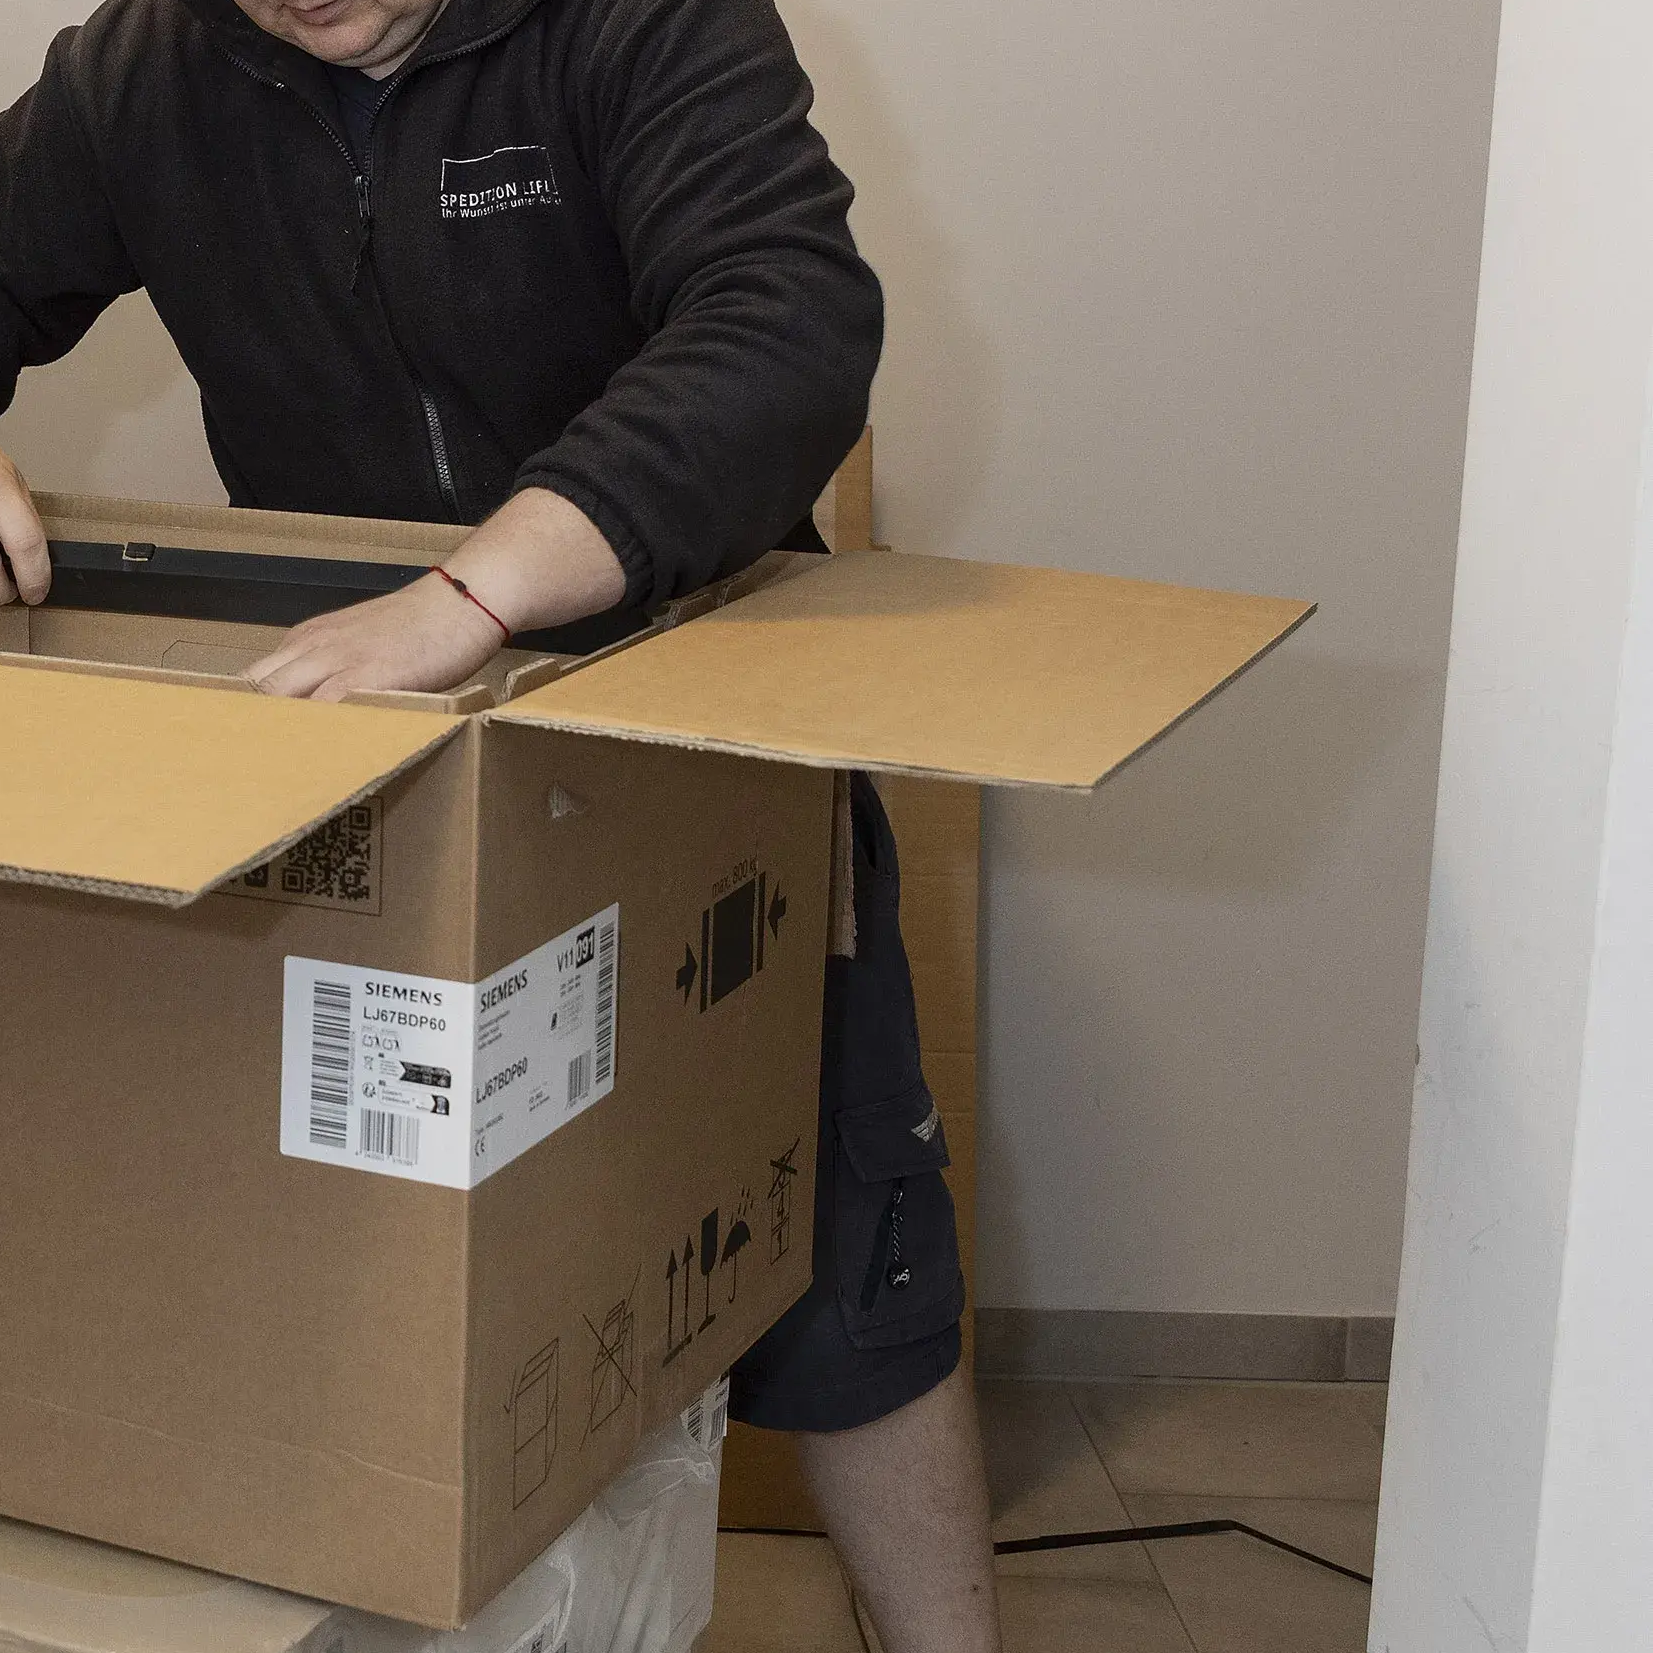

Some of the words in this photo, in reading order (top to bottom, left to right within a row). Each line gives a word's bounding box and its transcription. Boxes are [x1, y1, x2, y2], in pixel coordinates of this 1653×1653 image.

[440, 182, 517, 207] SPEDITION
[557, 947, 574, 973] V11
[576, 931, 595, 963] 091
[365, 981, 444, 1006] SIEMENS
[480, 968, 528, 1013] SIEMENS
[363, 1006, 447, 1031] LJ67BDP60
[476, 1056, 528, 1104] LJ67BDP60
